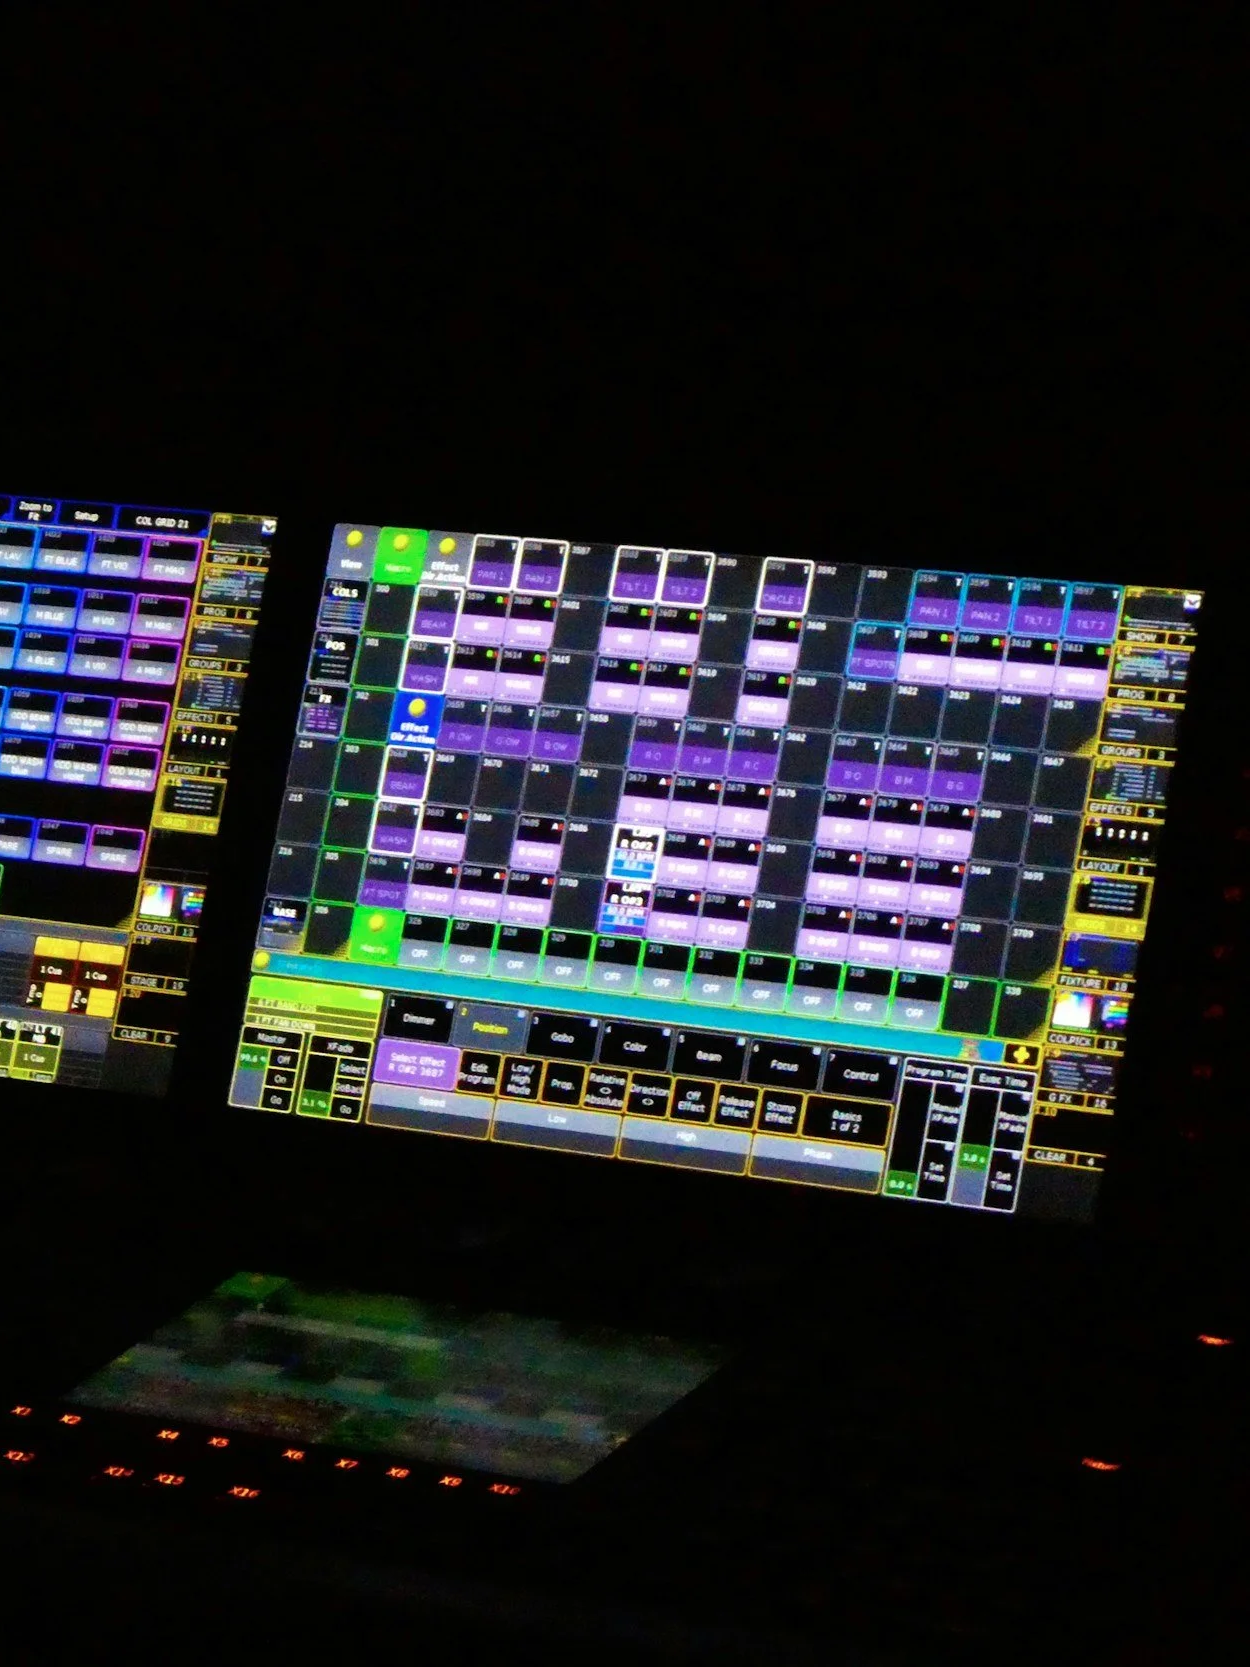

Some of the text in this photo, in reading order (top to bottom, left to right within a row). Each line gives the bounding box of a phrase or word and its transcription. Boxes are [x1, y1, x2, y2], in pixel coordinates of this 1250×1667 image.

[19, 502, 52, 512] Zoom to
[74, 511, 99, 523] Setup
[136, 516, 189, 529] COL GRID 21
[44, 555, 77, 566] FT BLUE
[213, 554, 238, 564] SHOW
[341, 560, 362, 569] View
[431, 562, 459, 572] Effect
[332, 588, 358, 598] COLS
[204, 607, 226, 616] PROG
[1127, 631, 1157, 643] SHOW
[325, 640, 345, 651] POS
[27, 655, 55, 667] A BLUE
[189, 660, 222, 670] GROUPS
[319, 694, 331, 703] FX
[1117, 688, 1144, 700] PROG
[177, 712, 213, 723] EFFECTS
[400, 723, 429, 732] Effect
[1101, 745, 1141, 757] GROUPS
[168, 765, 201, 775] LAYOUT
[1089, 803, 1132, 815] EFFECTS
[1081, 861, 1119, 872] LAYOUT
[273, 907, 297, 919] BASE
[136, 923, 172, 934] COLPICK
[130, 976, 157, 987] STAGE
[1060, 977, 1101, 988] FIXTURE
[753, 991, 770, 1000] OFF
[854, 1002, 872, 1012] OFF
[906, 1008, 923, 1018] OFF
[403, 1014, 436, 1026] Dimmer
[472, 1022, 509, 1035] Position
[120, 1029, 147, 1040] CLEAR
[258, 1033, 286, 1045] Master
[551, 1032, 574, 1044] Gobo
[623, 1041, 647, 1052] Color
[1049, 1034, 1118, 1050] COLPICK 13
[327, 1042, 354, 1054] XFade
[277, 1055, 291, 1064] Off
[391, 1053, 447, 1067] Select Effect
[696, 1050, 722, 1063] Beam
[340, 1064, 366, 1074] Select
[389, 1063, 394, 1071] R
[471, 1063, 488, 1073] Edit
[511, 1063, 534, 1073] Low/
[770, 1060, 799, 1072] Focus
[844, 1069, 879, 1081] Control
[906, 1065, 968, 1080] Program Time
[274, 1074, 287, 1083] On
[460, 1073, 495, 1085] Program
[511, 1074, 531, 1084] High
[590, 1074, 625, 1086] Relative
[979, 1074, 1028, 1088] Exec Time
[551, 1079, 575, 1090] Prop.
[507, 1085, 531, 1096] Mode
[631, 1085, 670, 1097] Direction
[686, 1091, 701, 1101] Off
[270, 1096, 282, 1105] Go
[419, 1097, 445, 1108] Speed
[585, 1095, 623, 1108] Absolute
[719, 1095, 755, 1109] Release
[1049, 1094, 1072, 1103] G FX
[1094, 1099, 1107, 1108] 16
[340, 1105, 352, 1115] Go
[678, 1101, 705, 1114] Effect
[767, 1102, 797, 1114] Stomp
[548, 1114, 566, 1124] Low
[721, 1107, 750, 1120] Effect
[765, 1113, 793, 1125] Effect
[832, 1110, 863, 1122] Basics
[840, 1123, 850, 1132] of
[853, 1125, 860, 1133] 2
[676, 1131, 696, 1142] High
[804, 1149, 832, 1160] Phase
[1034, 1151, 1065, 1162] CLEAR
[930, 1163, 944, 1172] Set
[924, 1173, 945, 1183] Time
[996, 1172, 1011, 1181] Set
[991, 1181, 1012, 1192] Time
[208, 1436, 230, 1448] X5
[282, 1449, 305, 1461] X6
[335, 1458, 359, 1469] X7
[386, 1466, 410, 1479] X8
[155, 1473, 185, 1486] X15
[439, 1475, 463, 1487] X9
[228, 1486, 259, 1498] X16
